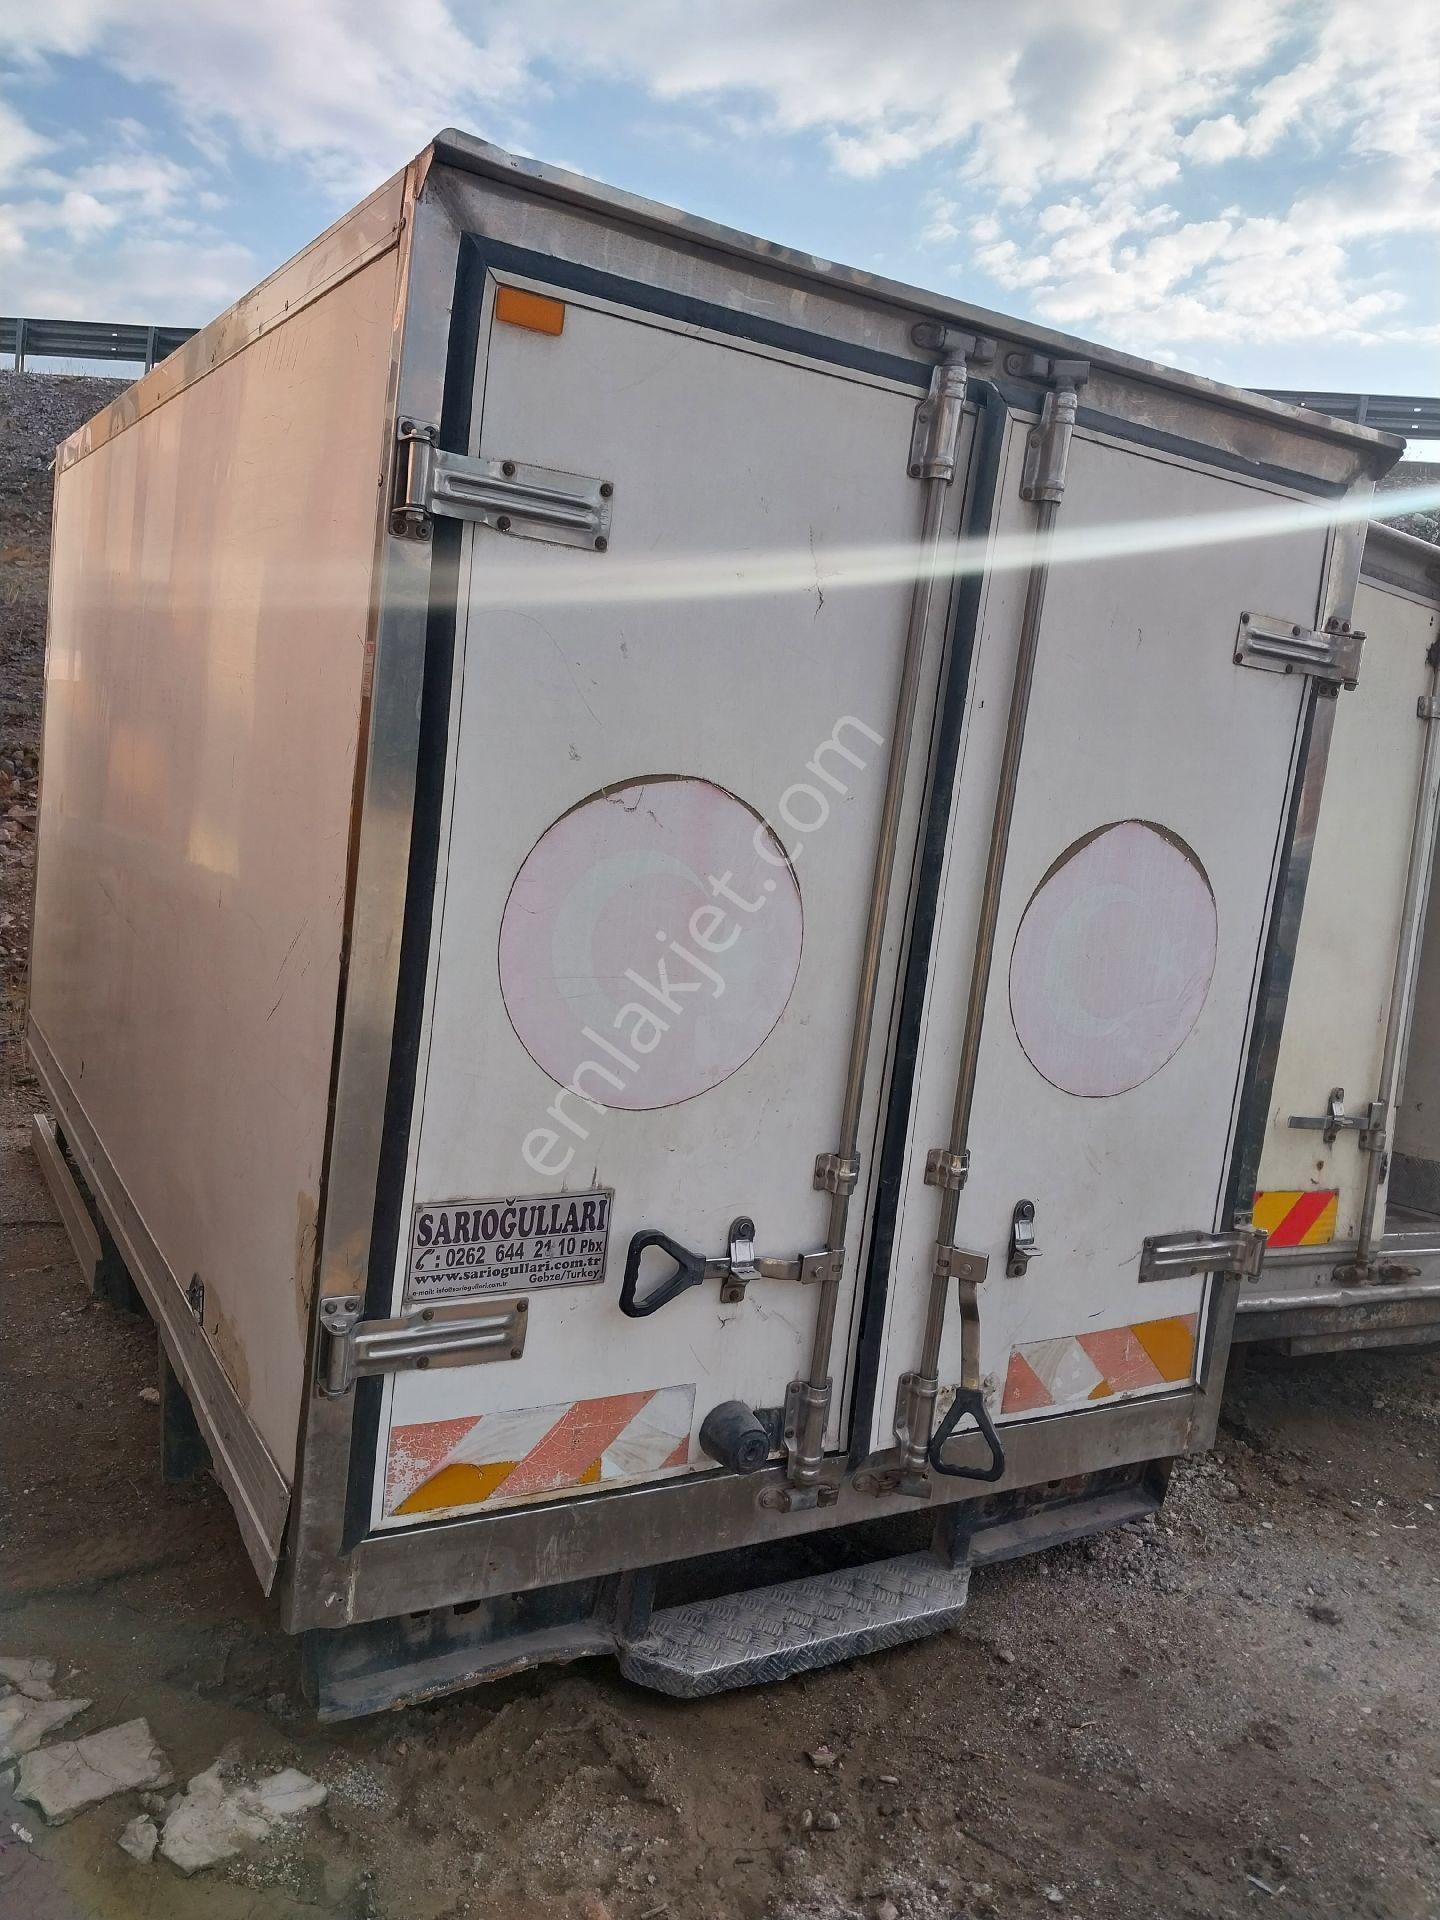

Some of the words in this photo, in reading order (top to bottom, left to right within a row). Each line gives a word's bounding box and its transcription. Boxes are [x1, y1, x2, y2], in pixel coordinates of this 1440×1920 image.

[416, 1197, 608, 1247] SARIOĞULLARI
[445, 1246, 486, 1267] 0262
[495, 1242, 524, 1262] 644
[558, 1237, 576, 1255] 10
[580, 1239, 603, 1253] Pbx
[414, 1256, 602, 1284] www.sariogullari.com.tr
